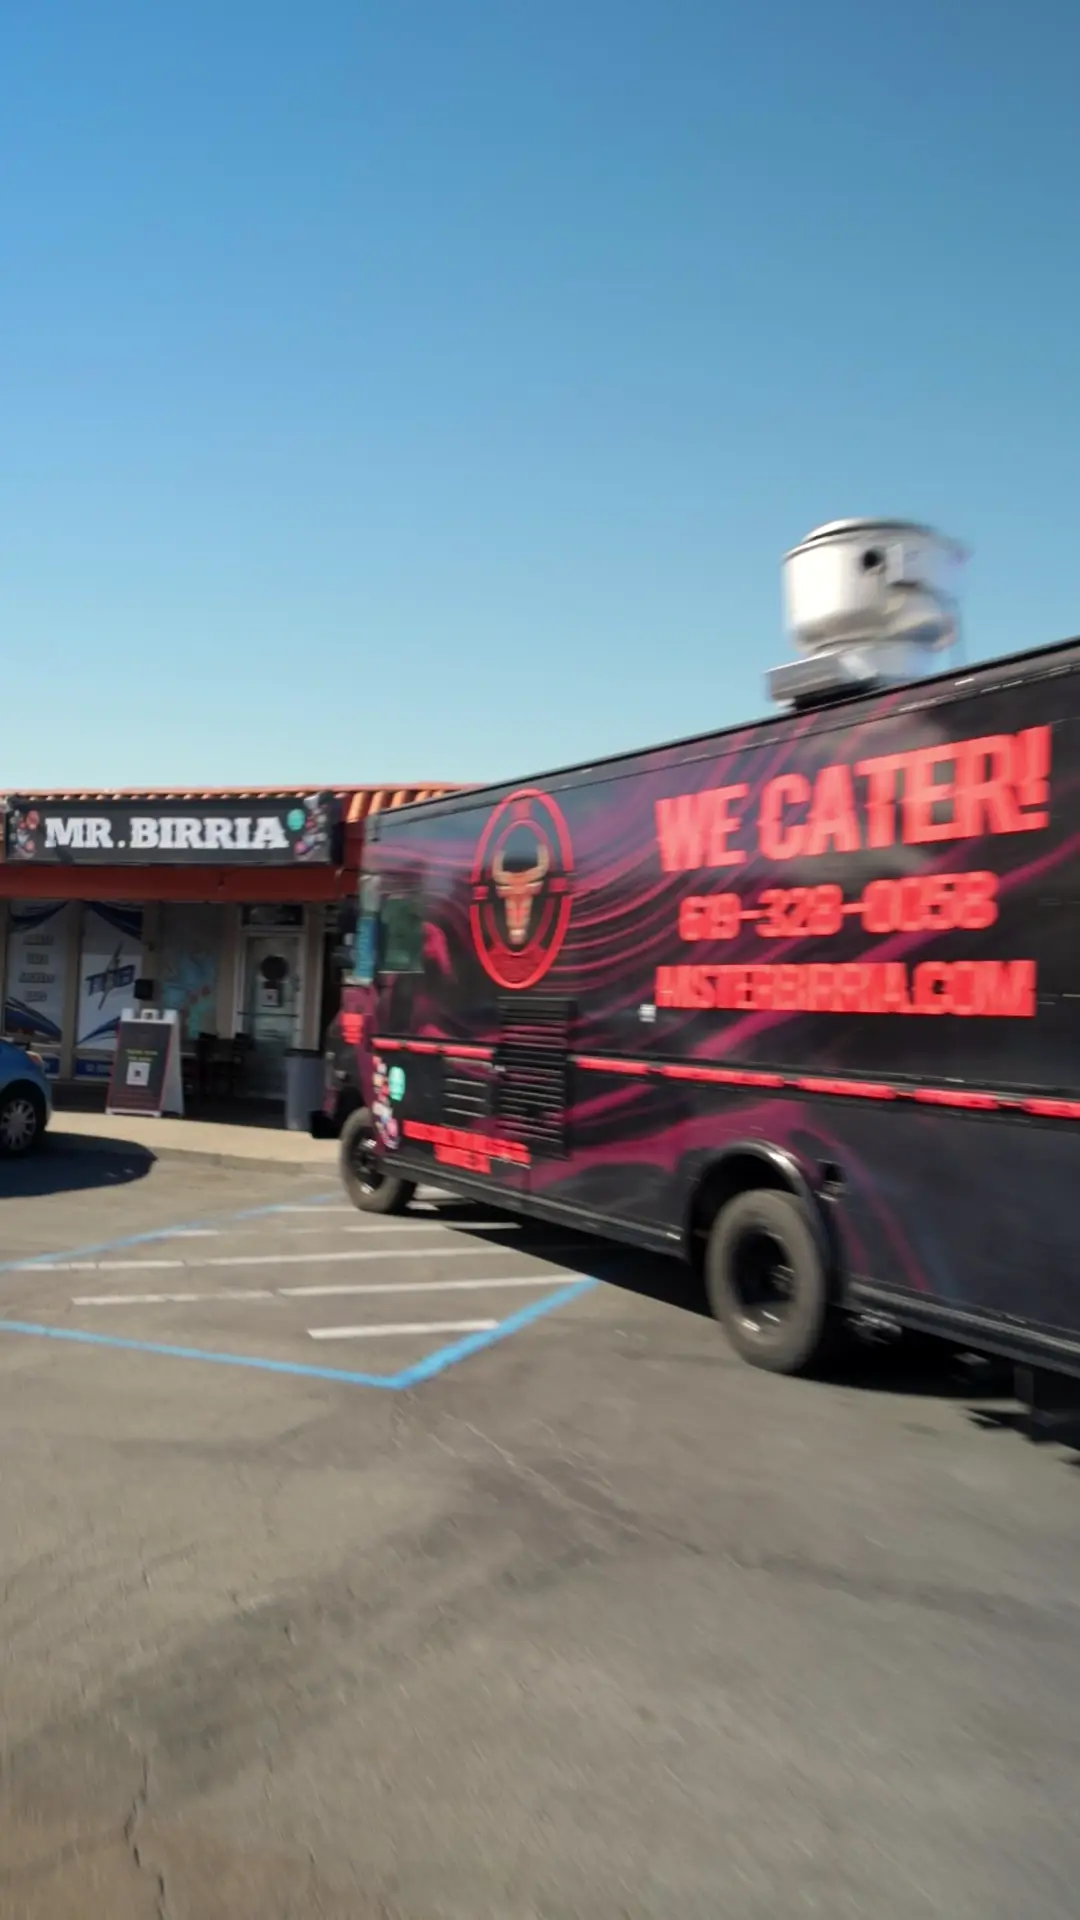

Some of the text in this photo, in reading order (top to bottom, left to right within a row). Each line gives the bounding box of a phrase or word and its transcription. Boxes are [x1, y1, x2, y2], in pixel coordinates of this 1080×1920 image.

[130, 816, 289, 849] BIRRIA
[655, 725, 1051, 872] WE CATER!
